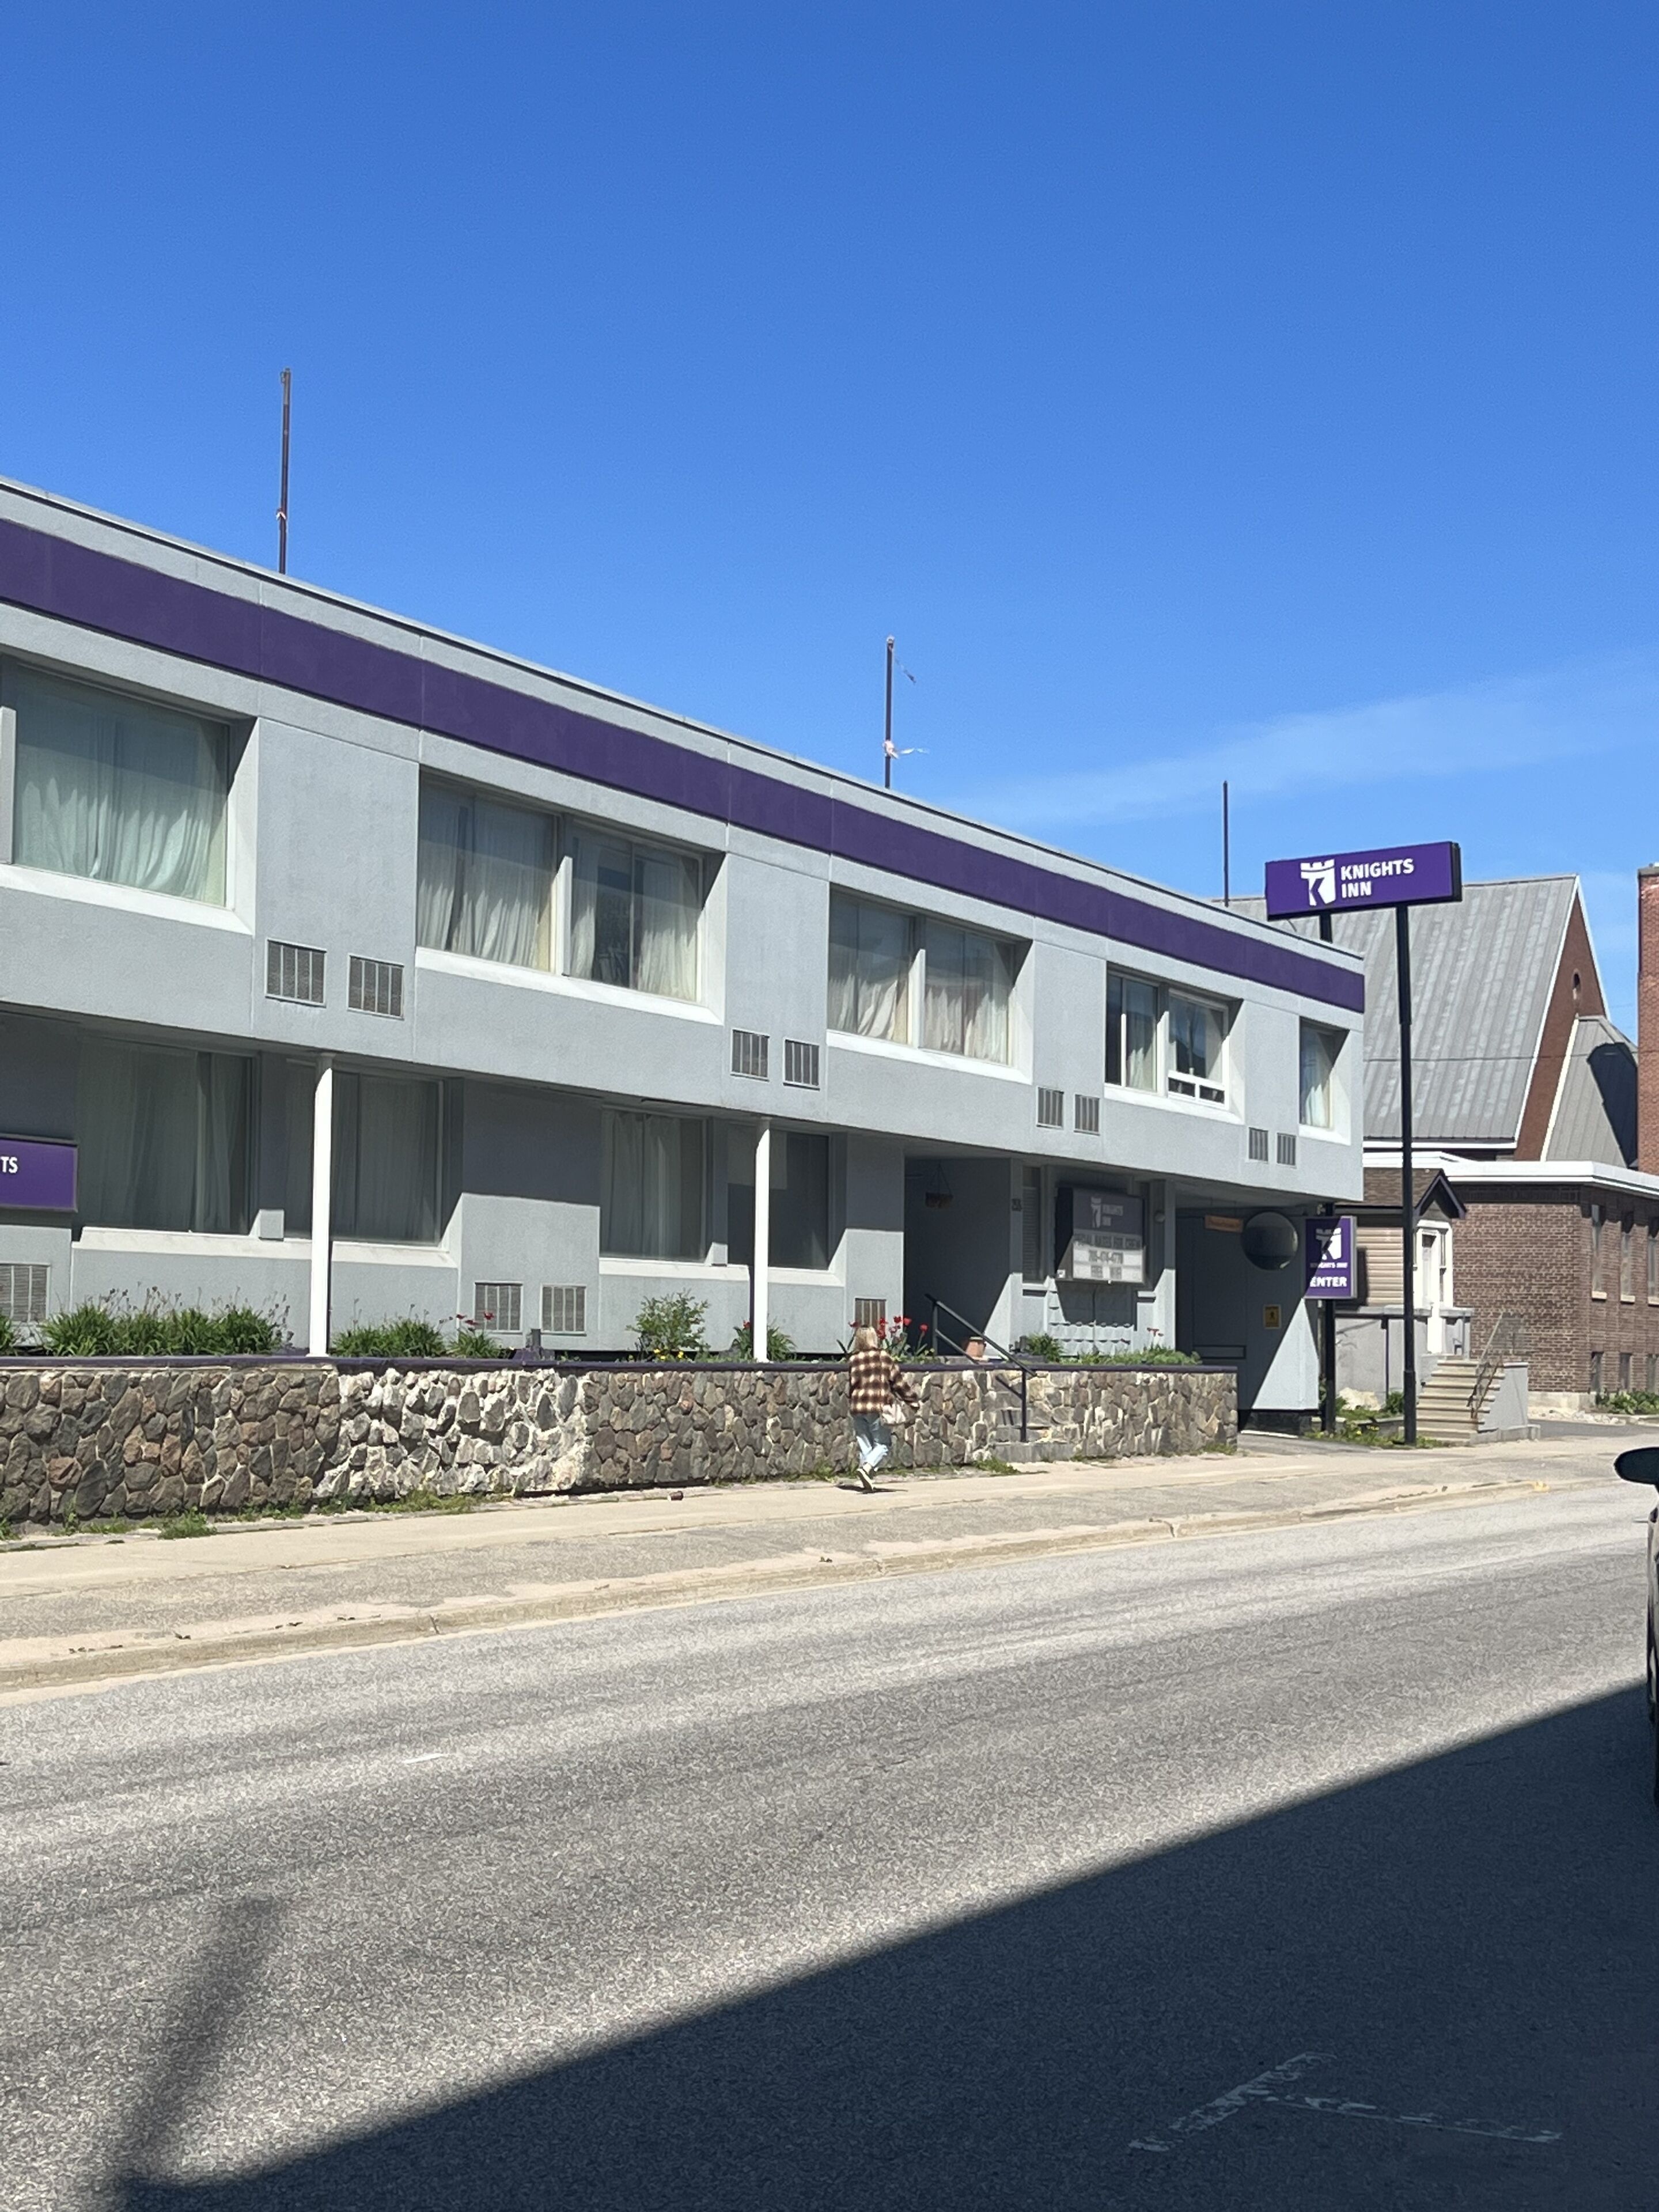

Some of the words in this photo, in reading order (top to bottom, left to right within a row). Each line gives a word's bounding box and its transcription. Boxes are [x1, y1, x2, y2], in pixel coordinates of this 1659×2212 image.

[1341, 858, 1414, 881] KNIGHTS
[1341, 881, 1372, 899] INN
[1310, 1276, 1347, 1288] ENTER
